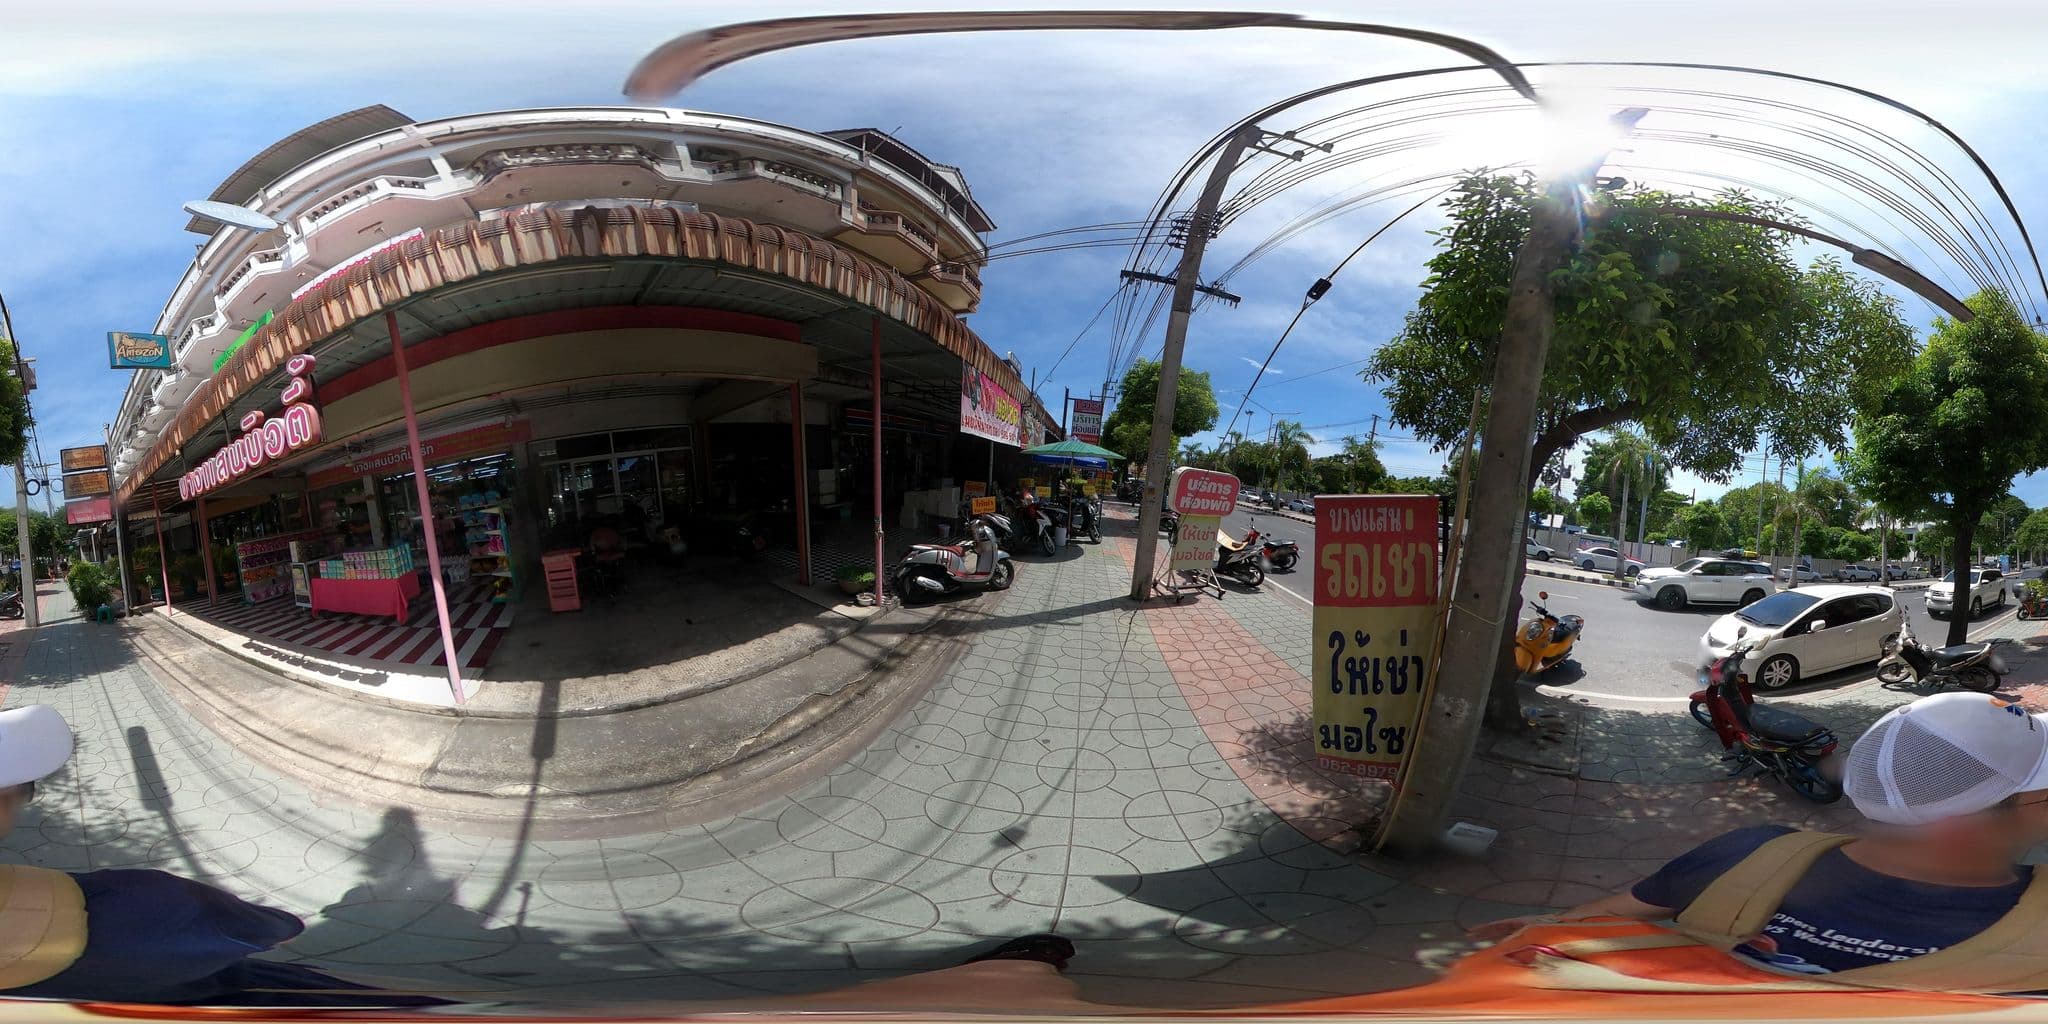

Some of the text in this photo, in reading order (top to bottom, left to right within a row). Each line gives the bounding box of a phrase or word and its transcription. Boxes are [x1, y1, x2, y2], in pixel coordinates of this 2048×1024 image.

[353, 443, 434, 474] บางแสนบิวตี้ร์ท
[1187, 476, 1233, 495] บริการ
[1180, 493, 1231, 512] ห้องพัก
[1329, 507, 1401, 533] บางแสน
[1328, 629, 1424, 696] ให้เช่า
[1319, 707, 1411, 755] มอไซ
